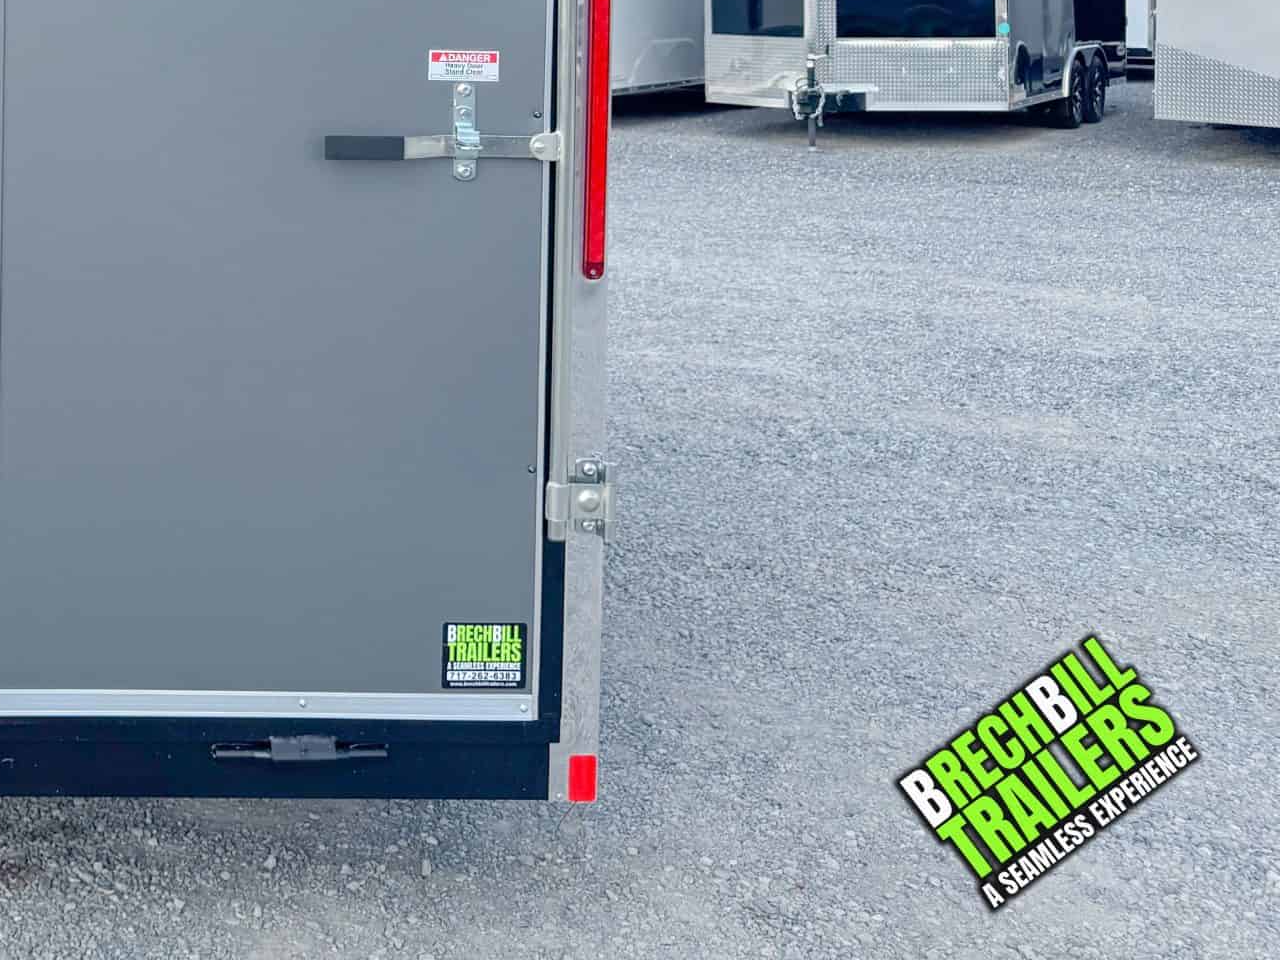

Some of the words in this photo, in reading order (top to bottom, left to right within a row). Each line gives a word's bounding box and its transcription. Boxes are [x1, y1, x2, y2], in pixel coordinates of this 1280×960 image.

[448, 53, 490, 63] DANGER
[447, 624, 522, 642] BRECHBILL
[447, 642, 522, 662] TRAILERS
